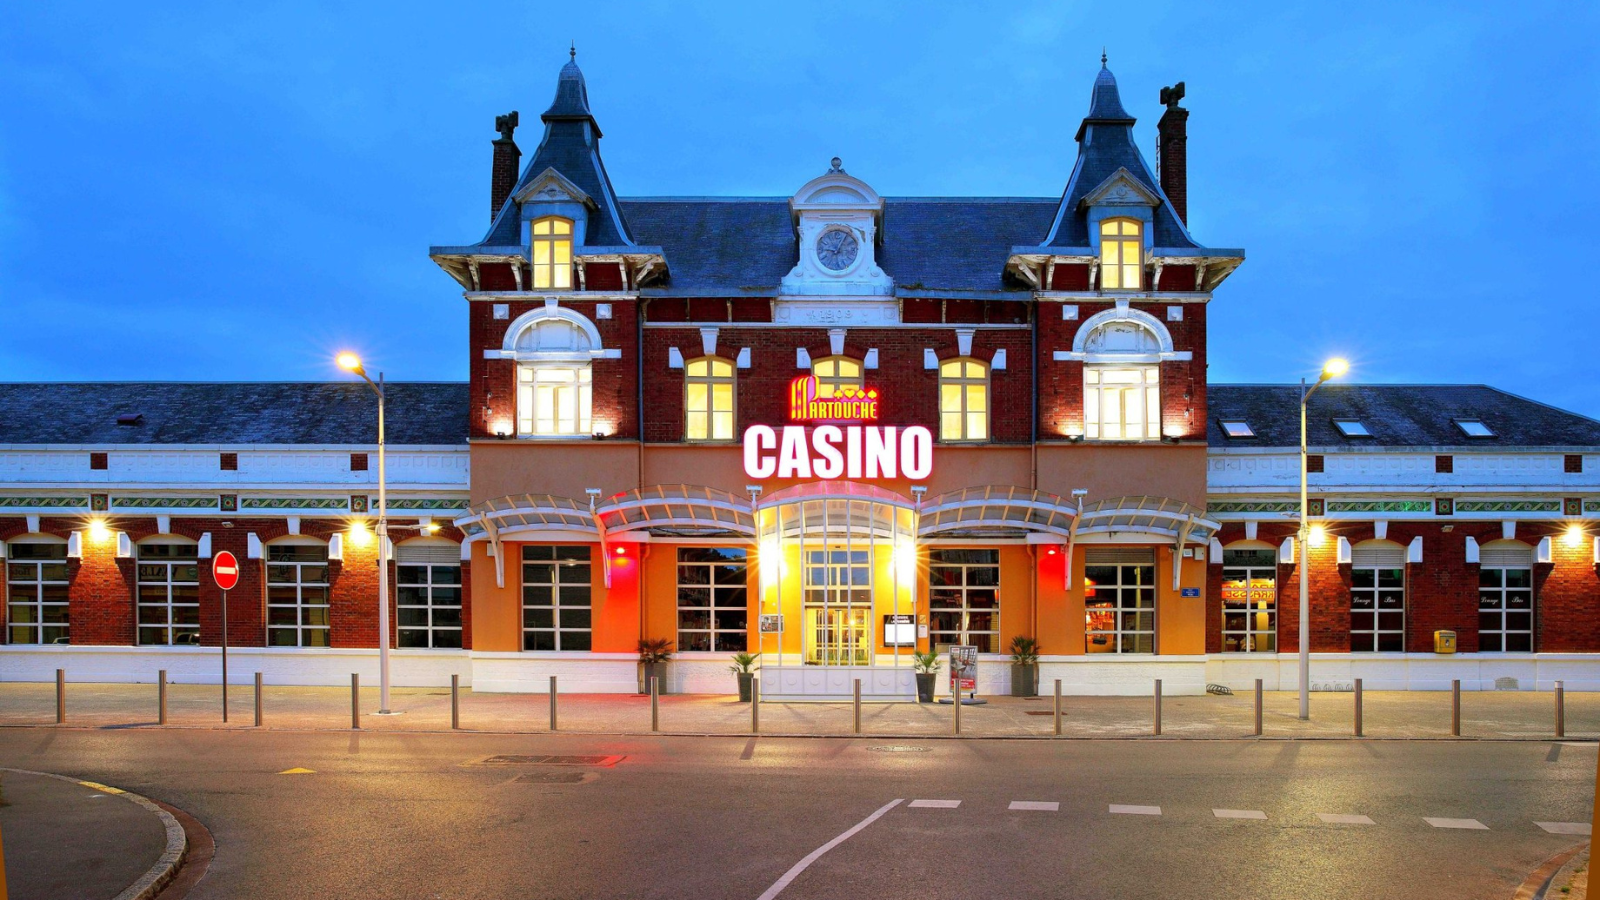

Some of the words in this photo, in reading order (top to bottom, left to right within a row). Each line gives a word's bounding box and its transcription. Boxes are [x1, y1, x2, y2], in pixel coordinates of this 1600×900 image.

[791, 375, 878, 420] PARTOUCHE
[743, 424, 933, 480] CASINO
[1353, 596, 1371, 605] Lounge
[1481, 597, 1498, 605] Lounge
